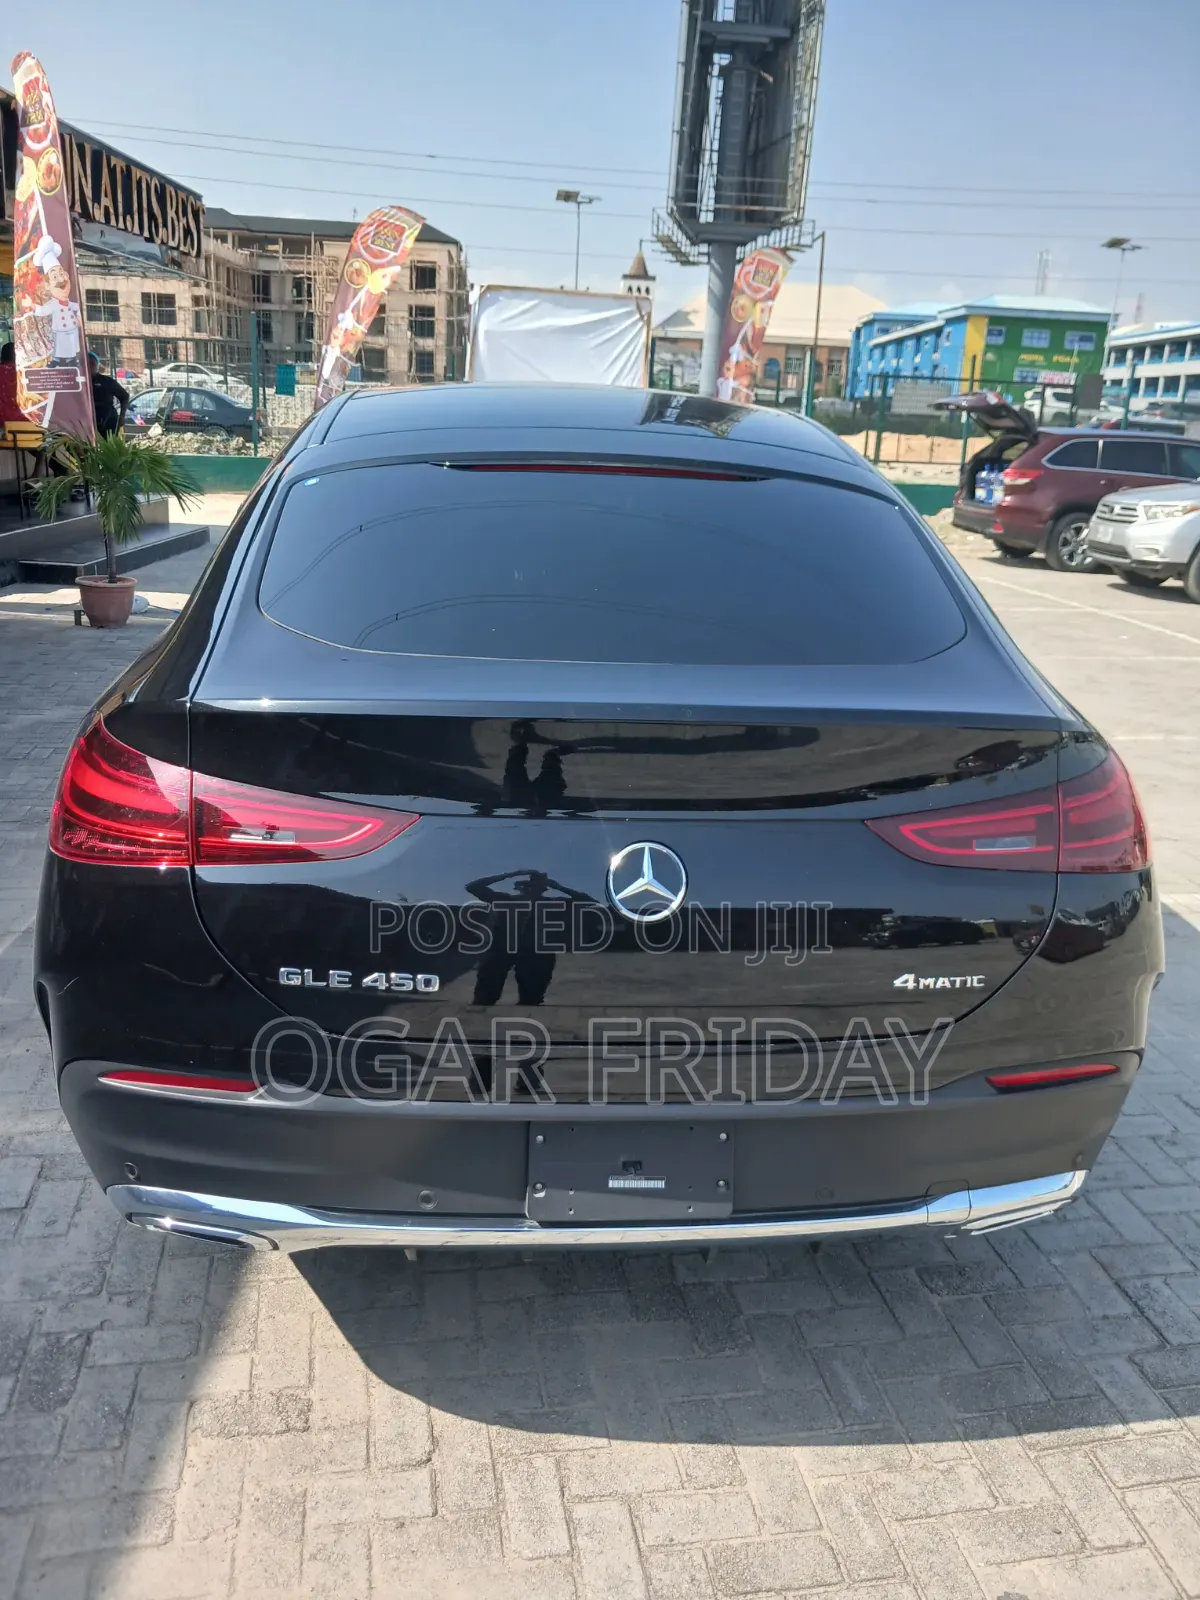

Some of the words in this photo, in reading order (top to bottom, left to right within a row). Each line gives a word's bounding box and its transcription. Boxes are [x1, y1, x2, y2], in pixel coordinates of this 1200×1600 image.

[278, 967, 352, 989] GLE
[361, 971, 440, 993] 450
[893, 973, 986, 990] 4MATIC
